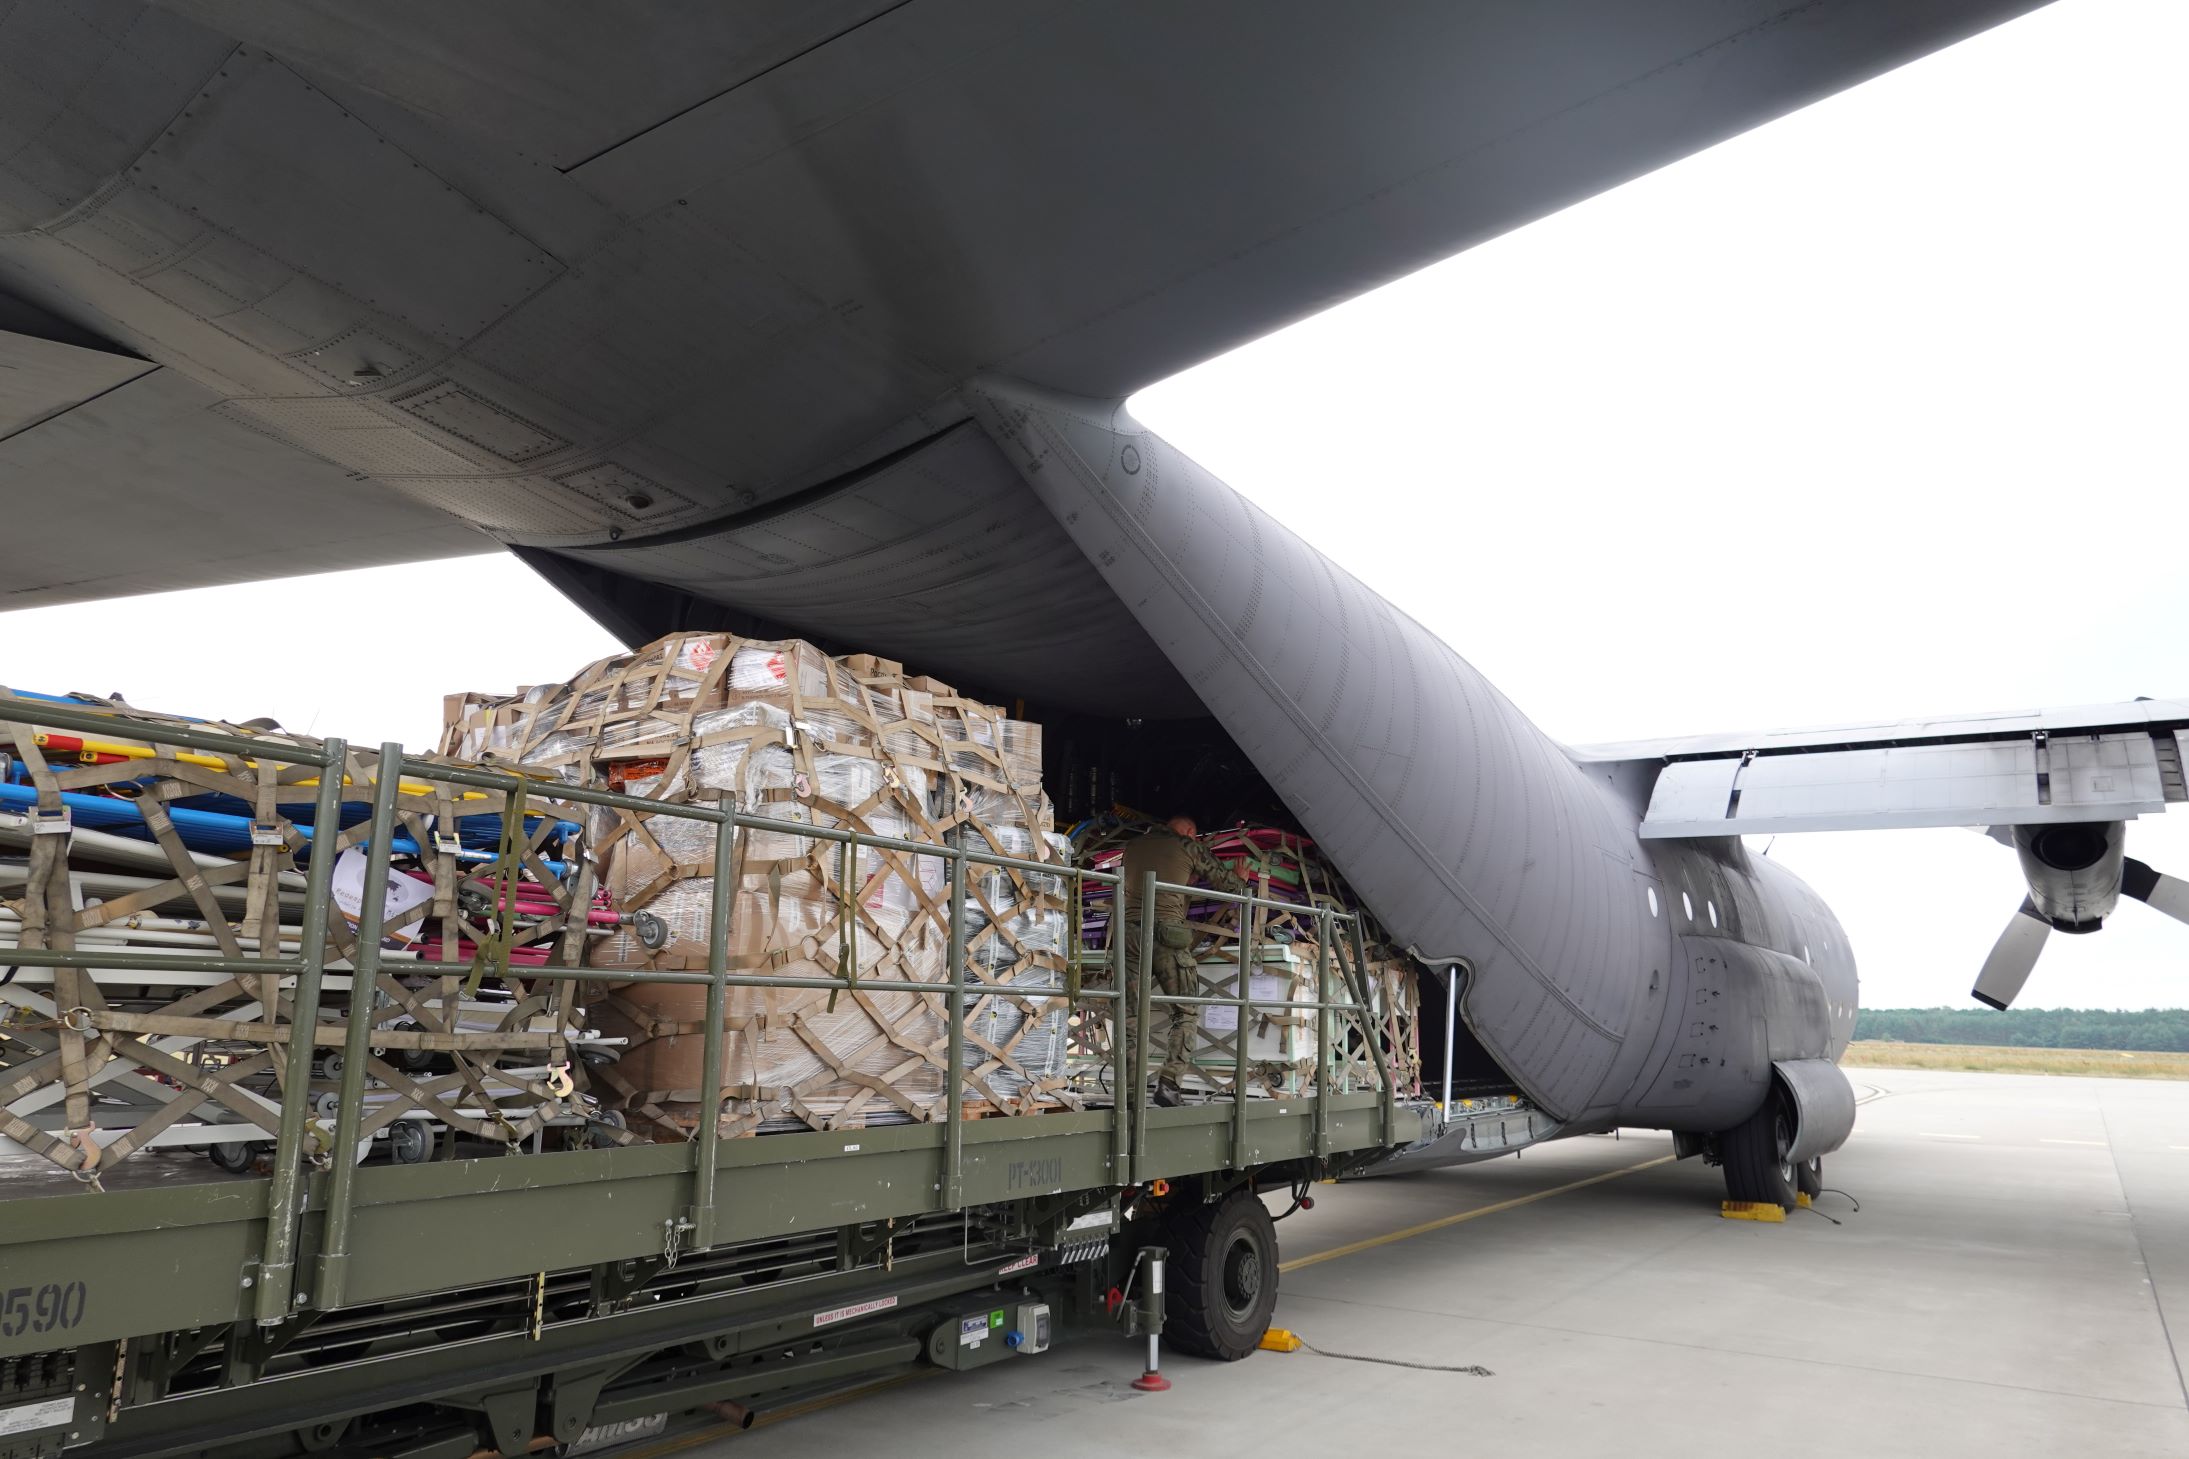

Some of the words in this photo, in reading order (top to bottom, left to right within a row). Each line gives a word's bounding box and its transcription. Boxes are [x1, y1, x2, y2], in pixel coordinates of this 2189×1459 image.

[0, 1281, 86, 1337] 590
[816, 1313, 834, 1325] UNLESS
[845, 1301, 879, 1317] MECHANICALLY
